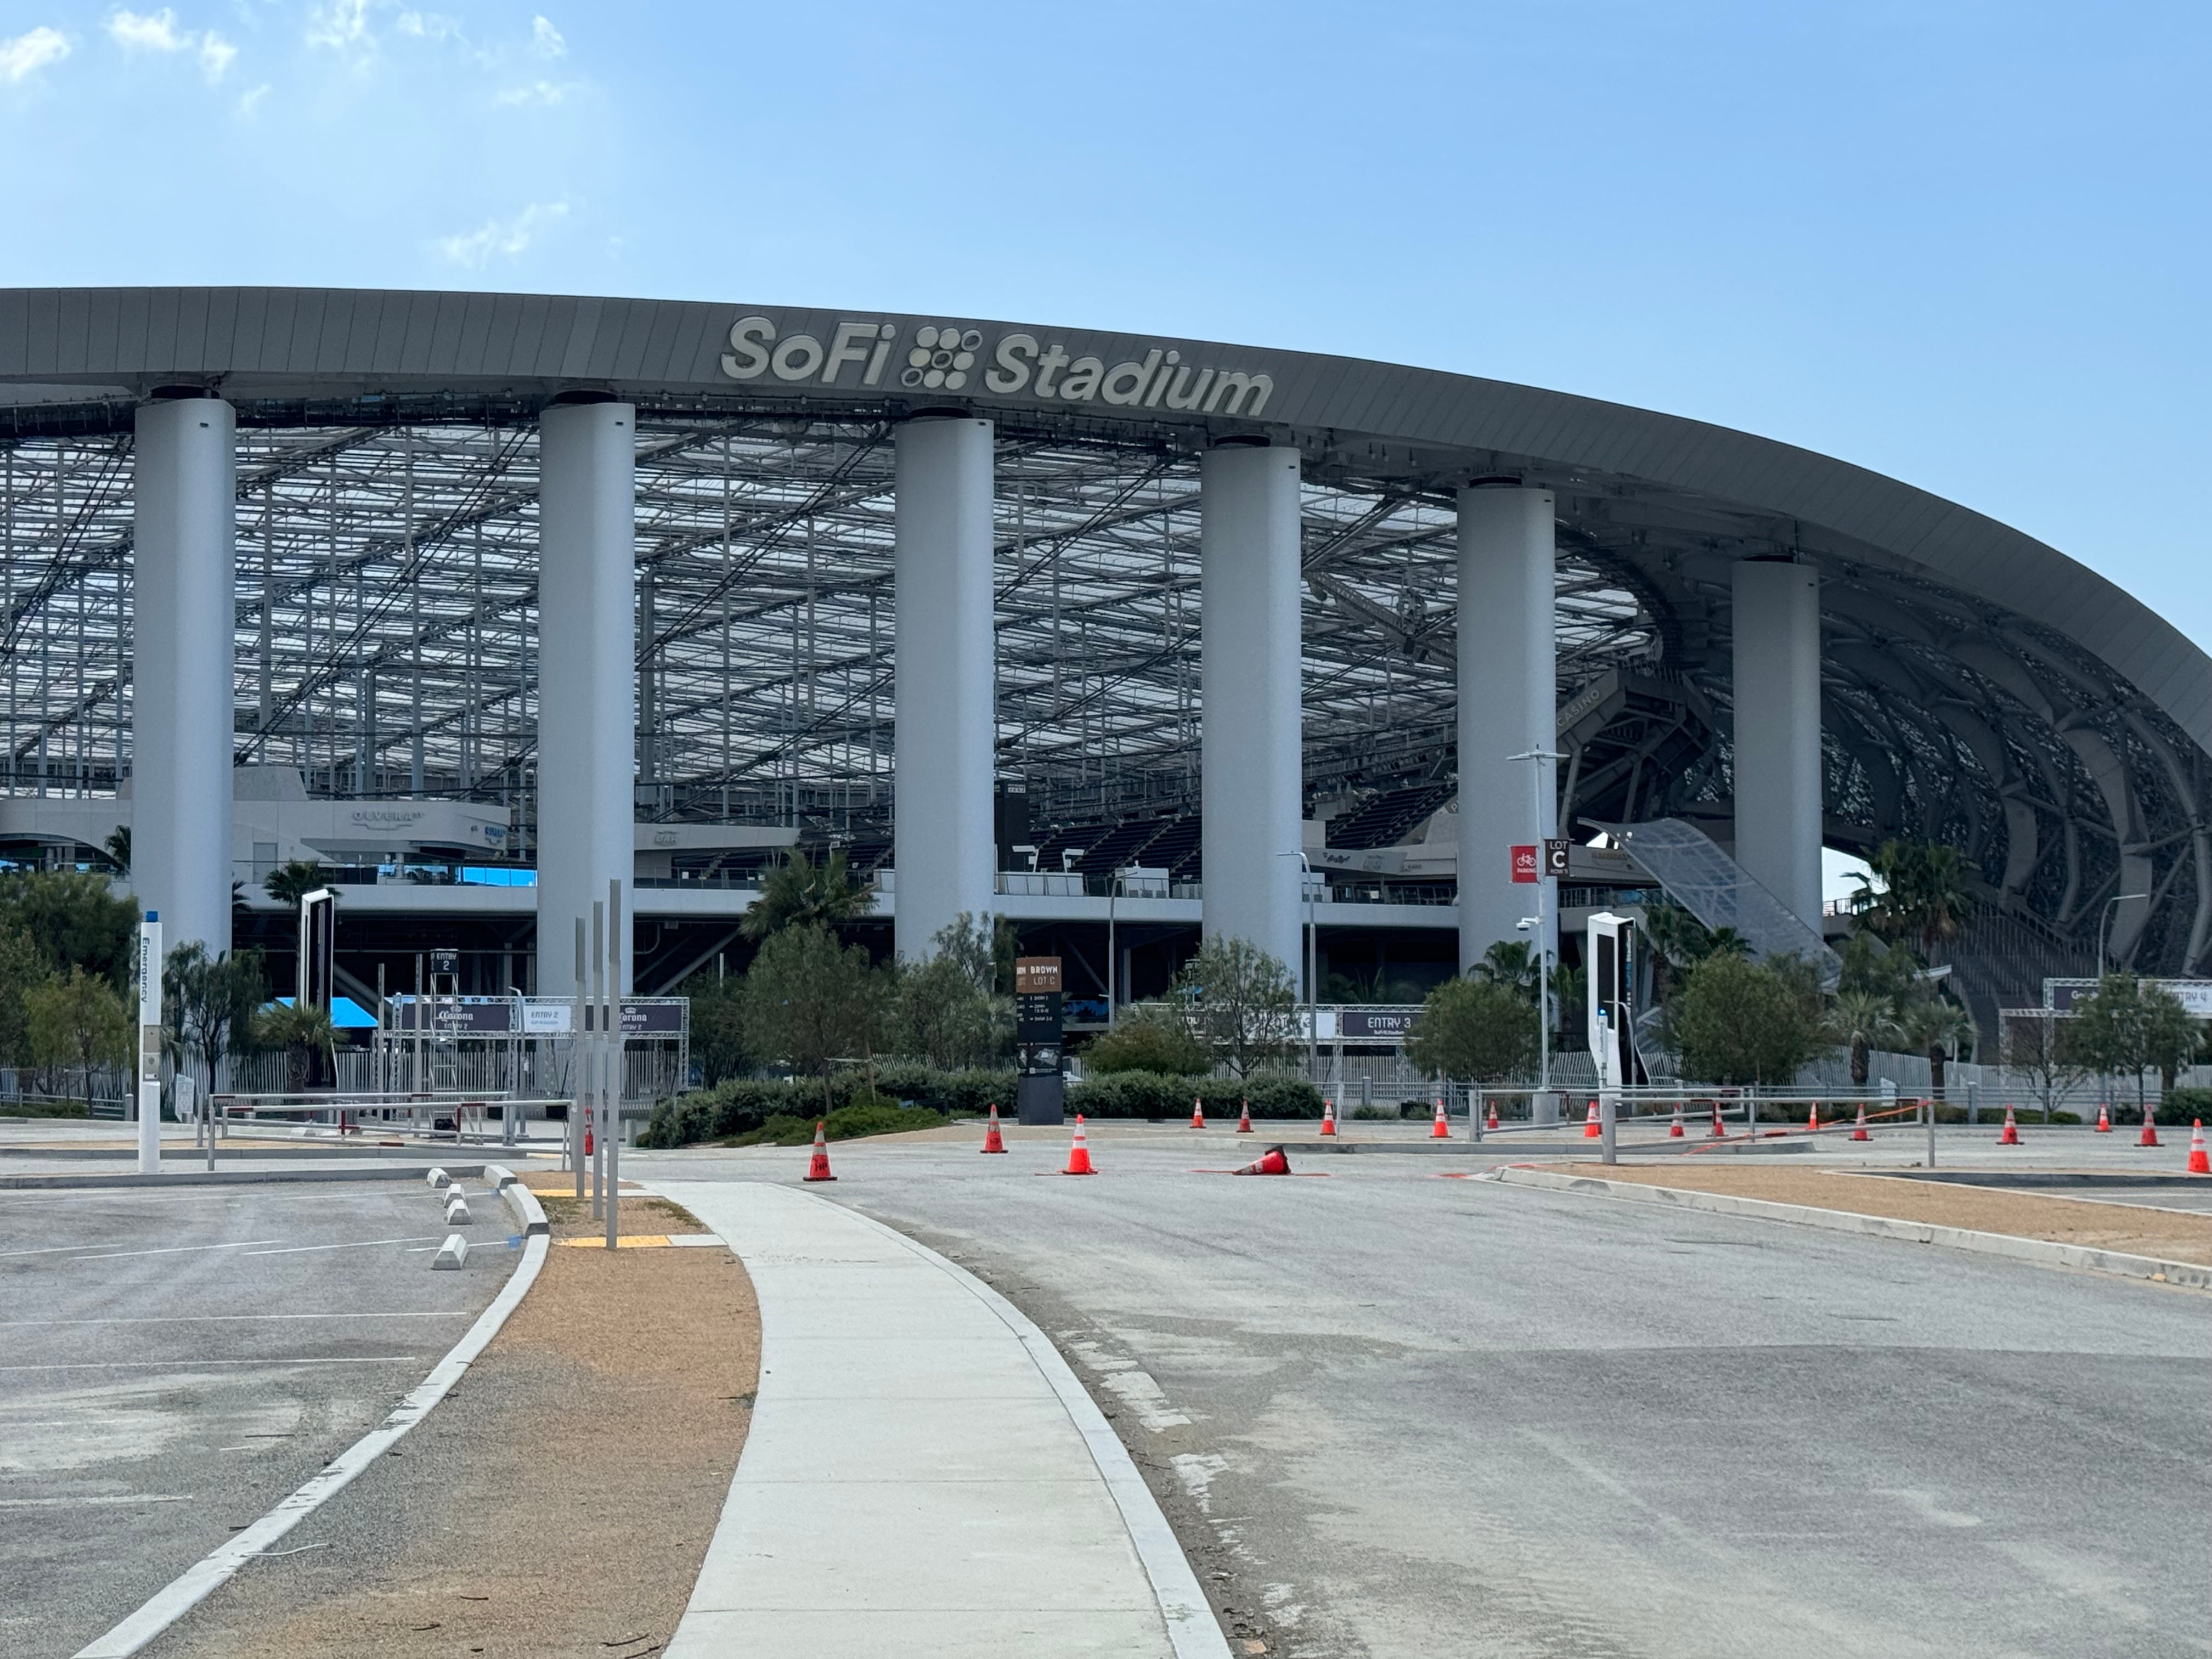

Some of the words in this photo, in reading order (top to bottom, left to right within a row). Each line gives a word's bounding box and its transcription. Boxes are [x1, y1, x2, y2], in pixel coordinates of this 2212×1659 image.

[721, 317, 896, 385] SoFi
[985, 334, 1274, 416] Stadium
[1557, 690, 1599, 727] CASINO
[353, 811, 411, 821] OLVERA
[1553, 851, 1565, 868] C
[141, 937, 150, 1003] Emergency
[443, 960, 450, 970] 2
[1030, 966, 1058, 974] BROWN
[1034, 977, 1047, 985] LOT
[1050, 977, 1055, 985] C
[438, 1011, 473, 1022] Corona
[1368, 1018, 1401, 1028] ENTRY
[1404, 1018, 1411, 1028] 3
